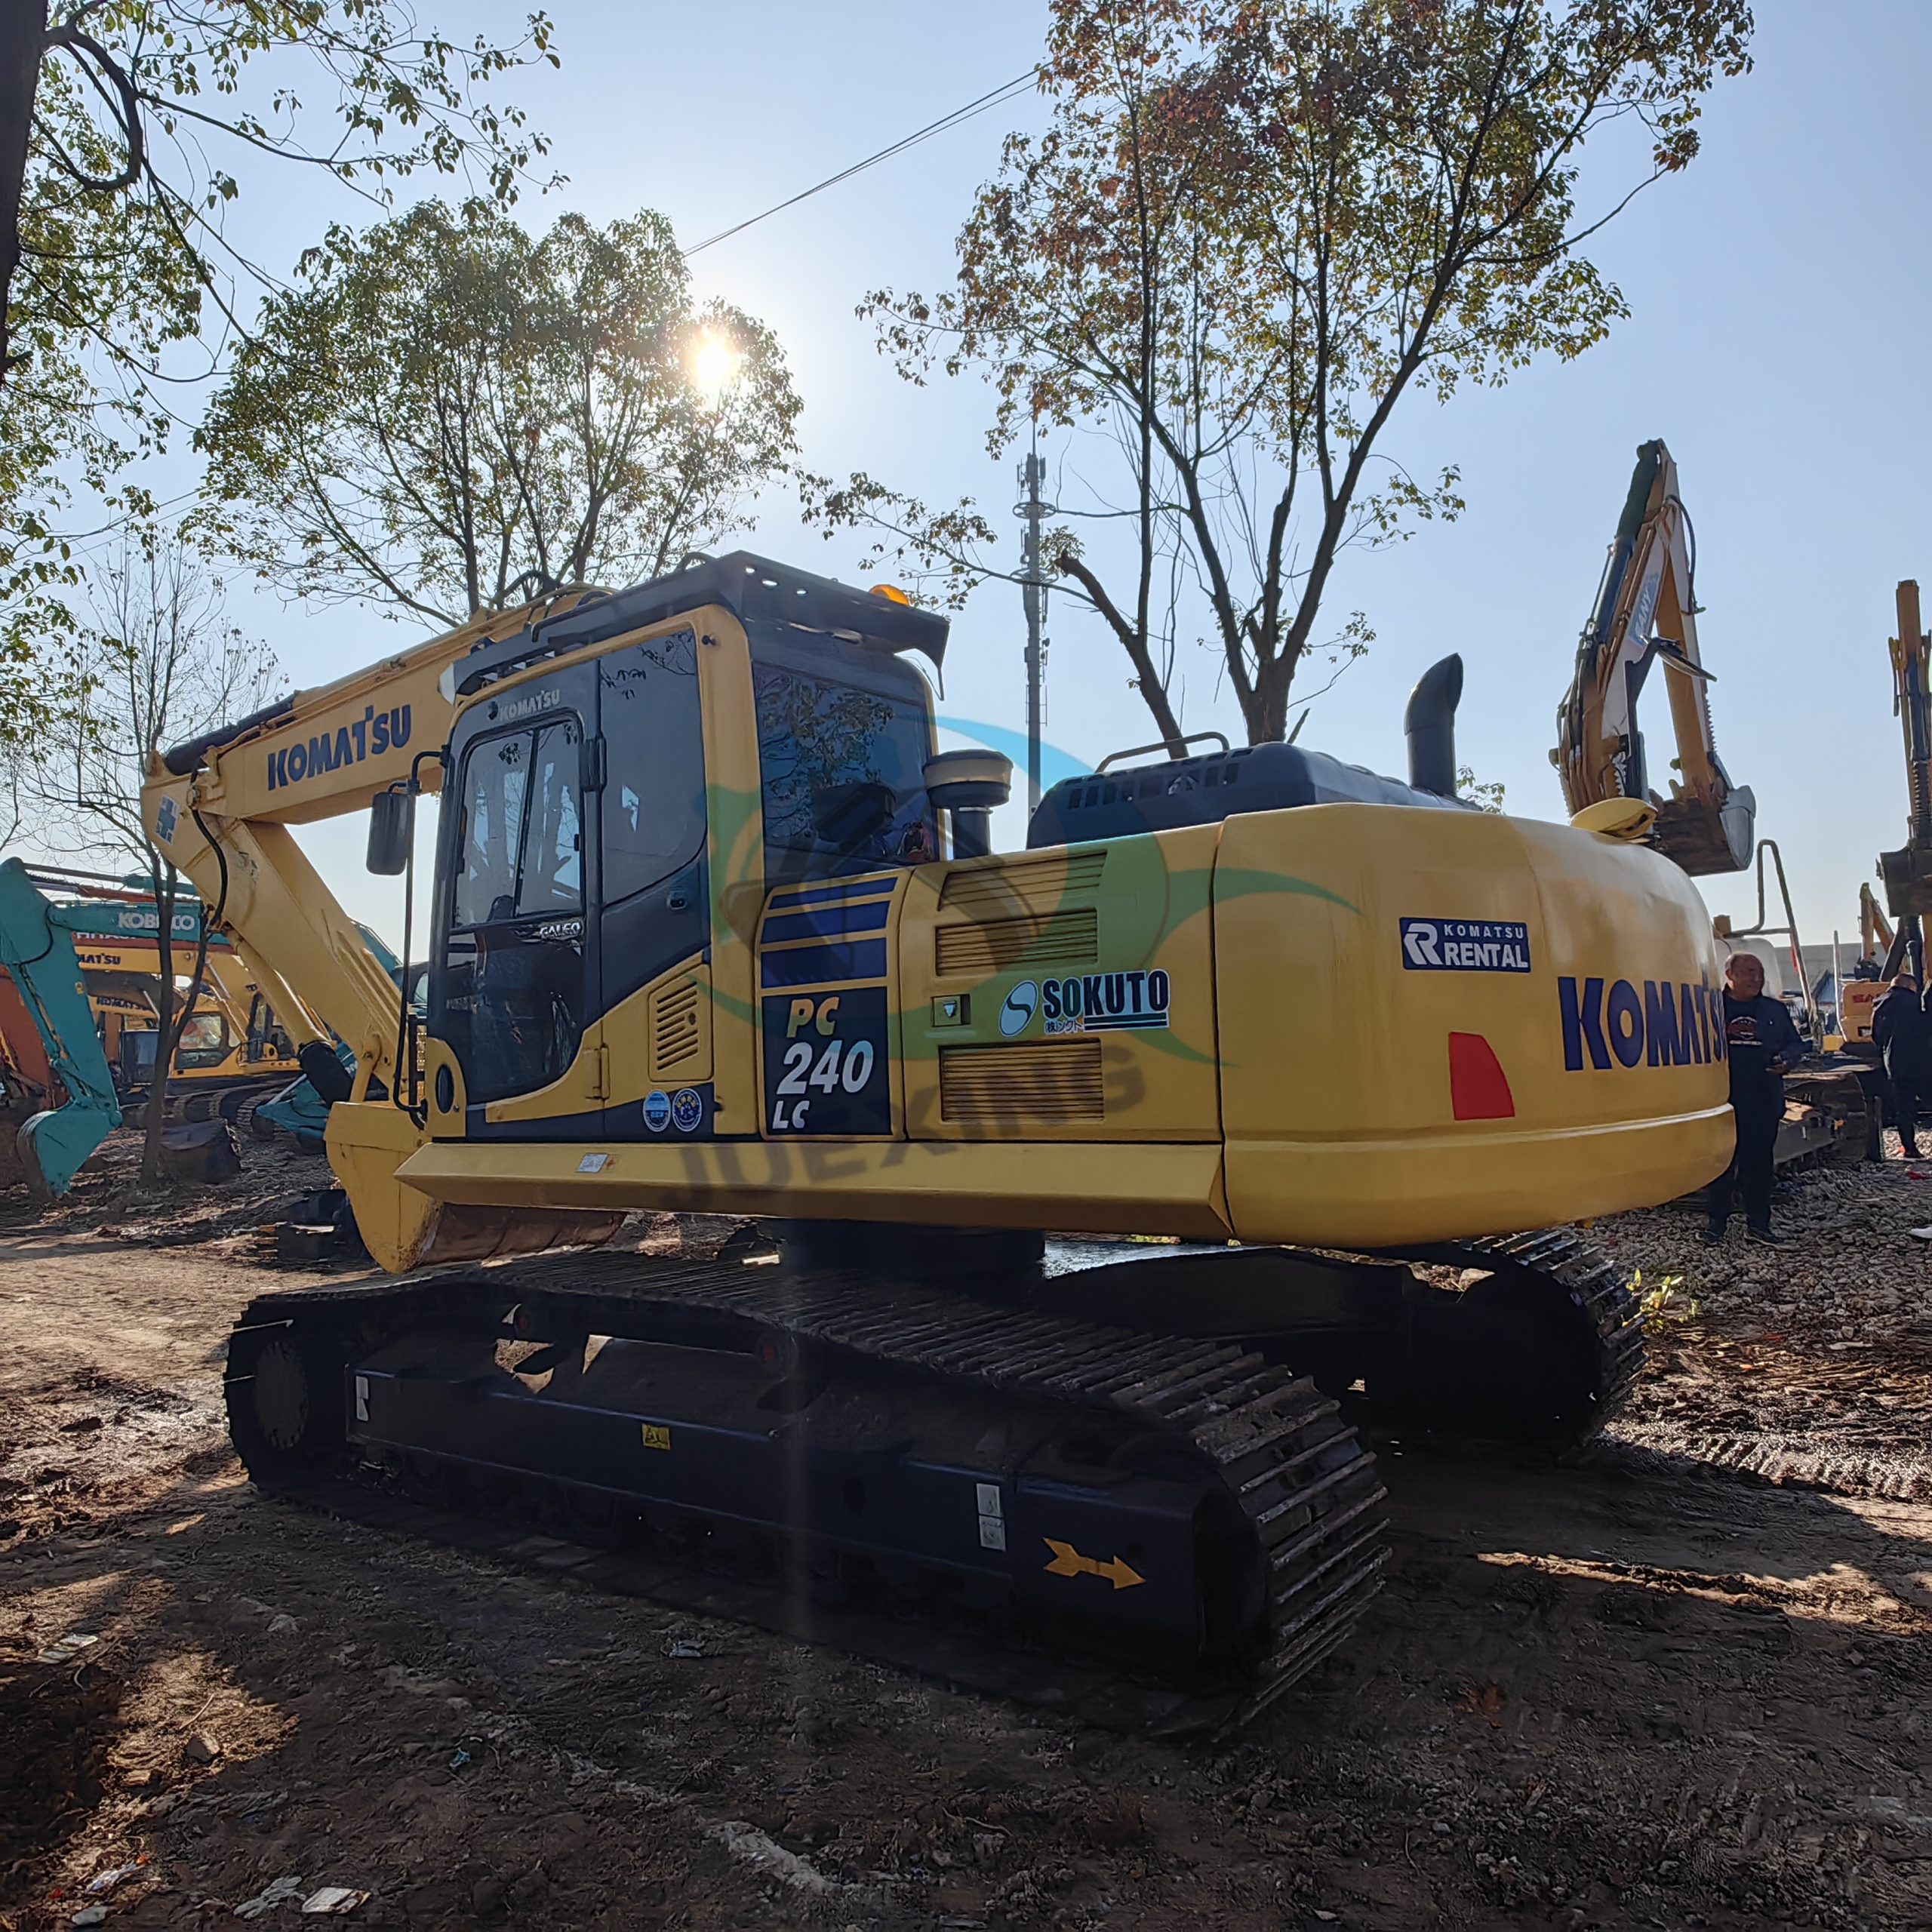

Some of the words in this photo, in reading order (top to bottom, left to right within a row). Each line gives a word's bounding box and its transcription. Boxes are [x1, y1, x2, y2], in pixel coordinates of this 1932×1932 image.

[499, 688, 560, 721] KOMATSU
[268, 704, 411, 791] KOMATSU
[118, 912, 195, 931] KOBCO
[1444, 924, 1524, 940] KOMATSU
[1444, 942, 1529, 968] RENTAL
[1042, 971, 1169, 1019] SOKUTO
[786, 996, 840, 1038] PC
[777, 1040, 875, 1095] 240
[772, 1100, 811, 1129] LC
